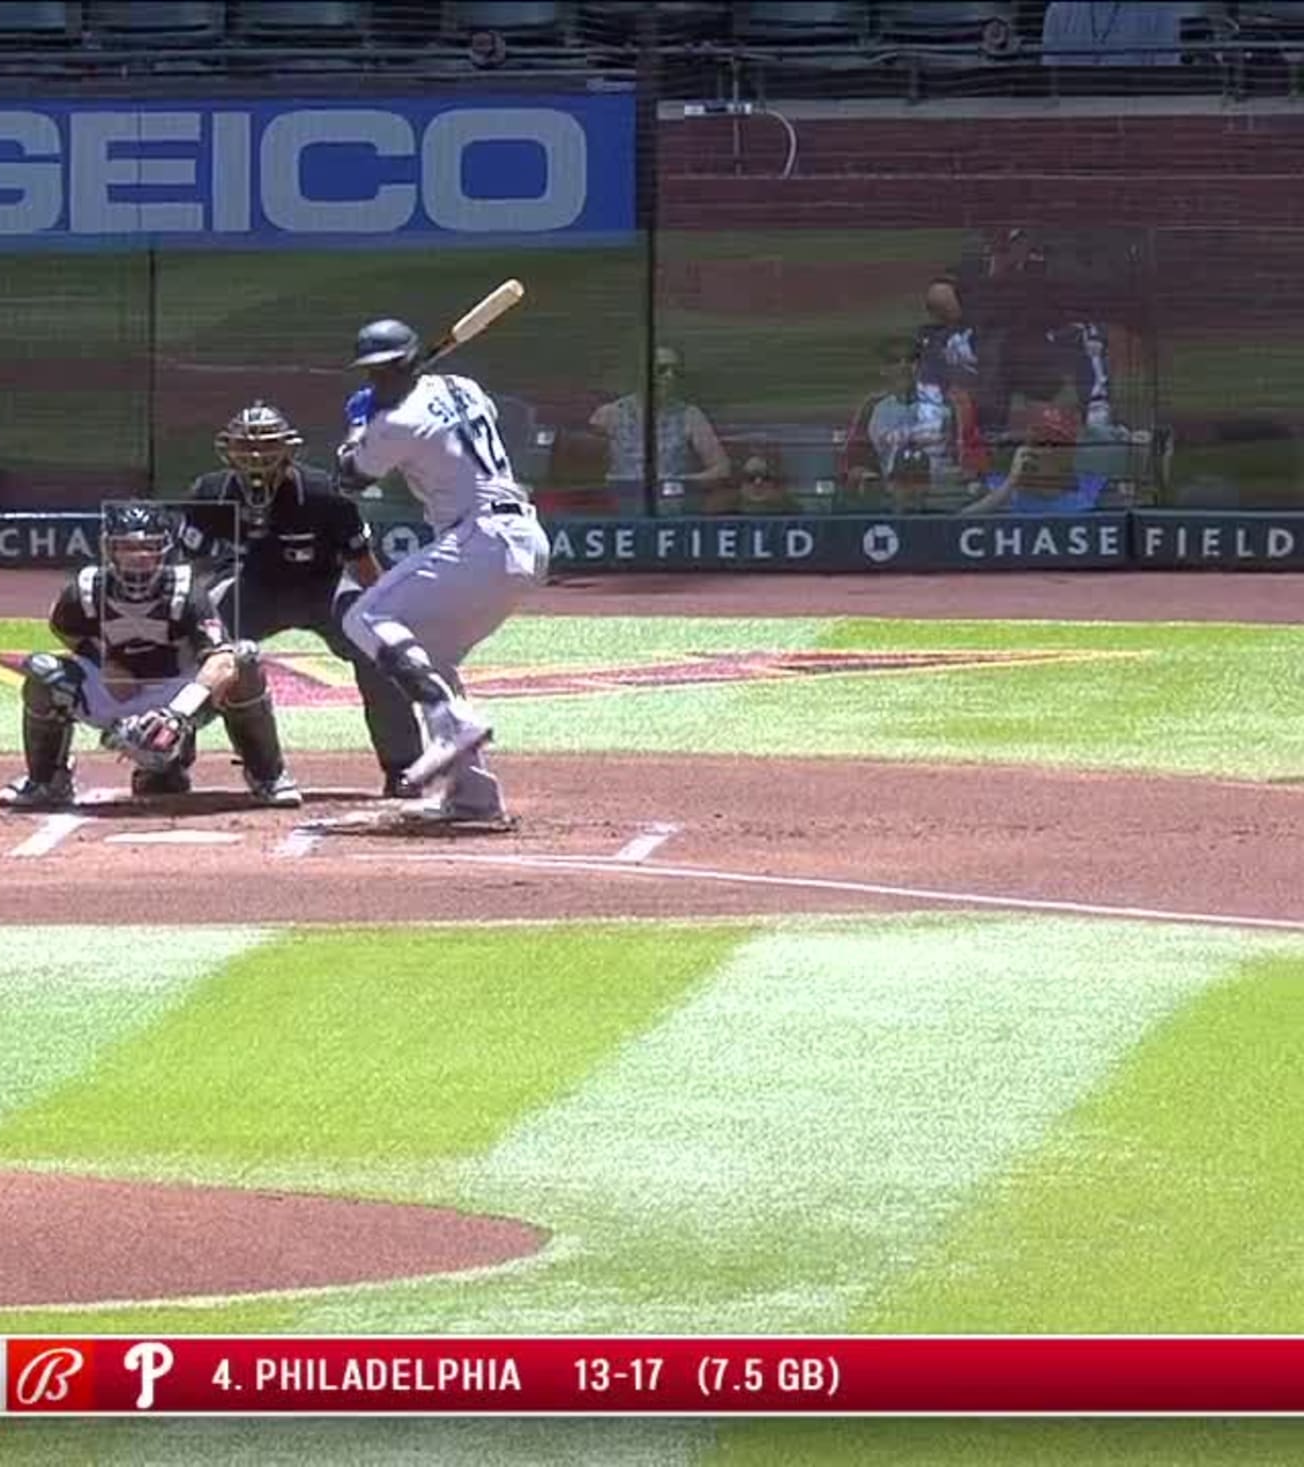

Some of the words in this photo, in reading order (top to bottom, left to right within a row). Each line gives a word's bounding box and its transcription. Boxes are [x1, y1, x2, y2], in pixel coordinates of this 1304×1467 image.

[550, 529, 635, 558] ASE
[658, 529, 814, 558] FIELD
[960, 526, 1119, 557] CHASE
[1146, 528, 1295, 558] FIELD
